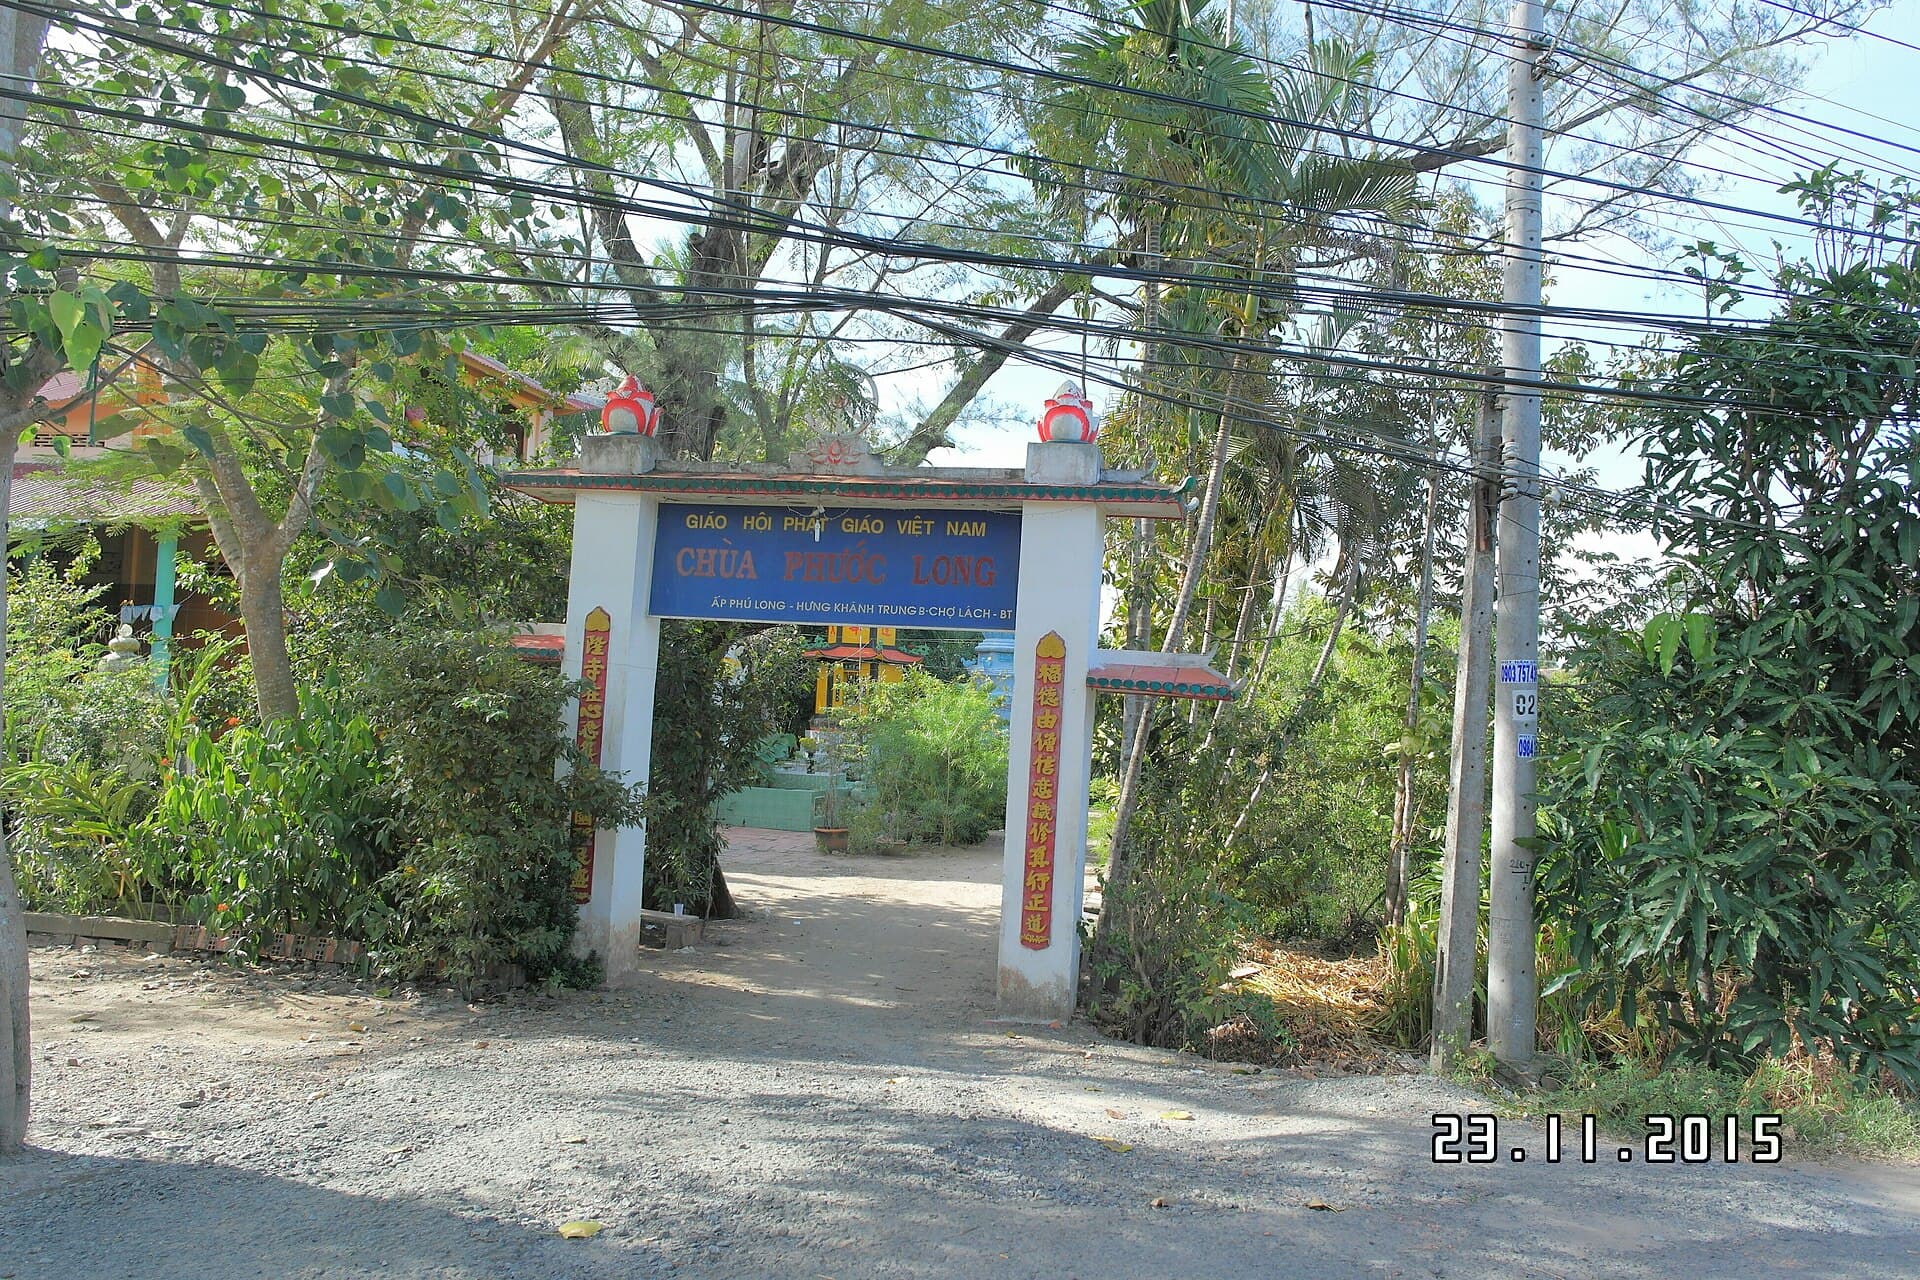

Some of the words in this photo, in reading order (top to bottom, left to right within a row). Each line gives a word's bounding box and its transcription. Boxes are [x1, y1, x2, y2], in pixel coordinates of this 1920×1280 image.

[685, 511, 728, 530] GIÁO
[743, 511, 773, 533] HỘI
[841, 514, 884, 534] GIÁO
[896, 515, 935, 537] VIỆT
[946, 521, 986, 537] NAM
[675, 537, 758, 580] CHÙA
[784, 540, 887, 585] PHƯỚC
[912, 555, 998, 587] LONG
[729, 597, 752, 609] PHÚ
[754, 600, 786, 610] LONG
[796, 600, 831, 612] HƯNG
[878, 604, 917, 615] TRUNG
[958, 605, 991, 618] LÁCH
[999, 610, 1013, 619] BT
[1516, 694, 1536, 716] 02
